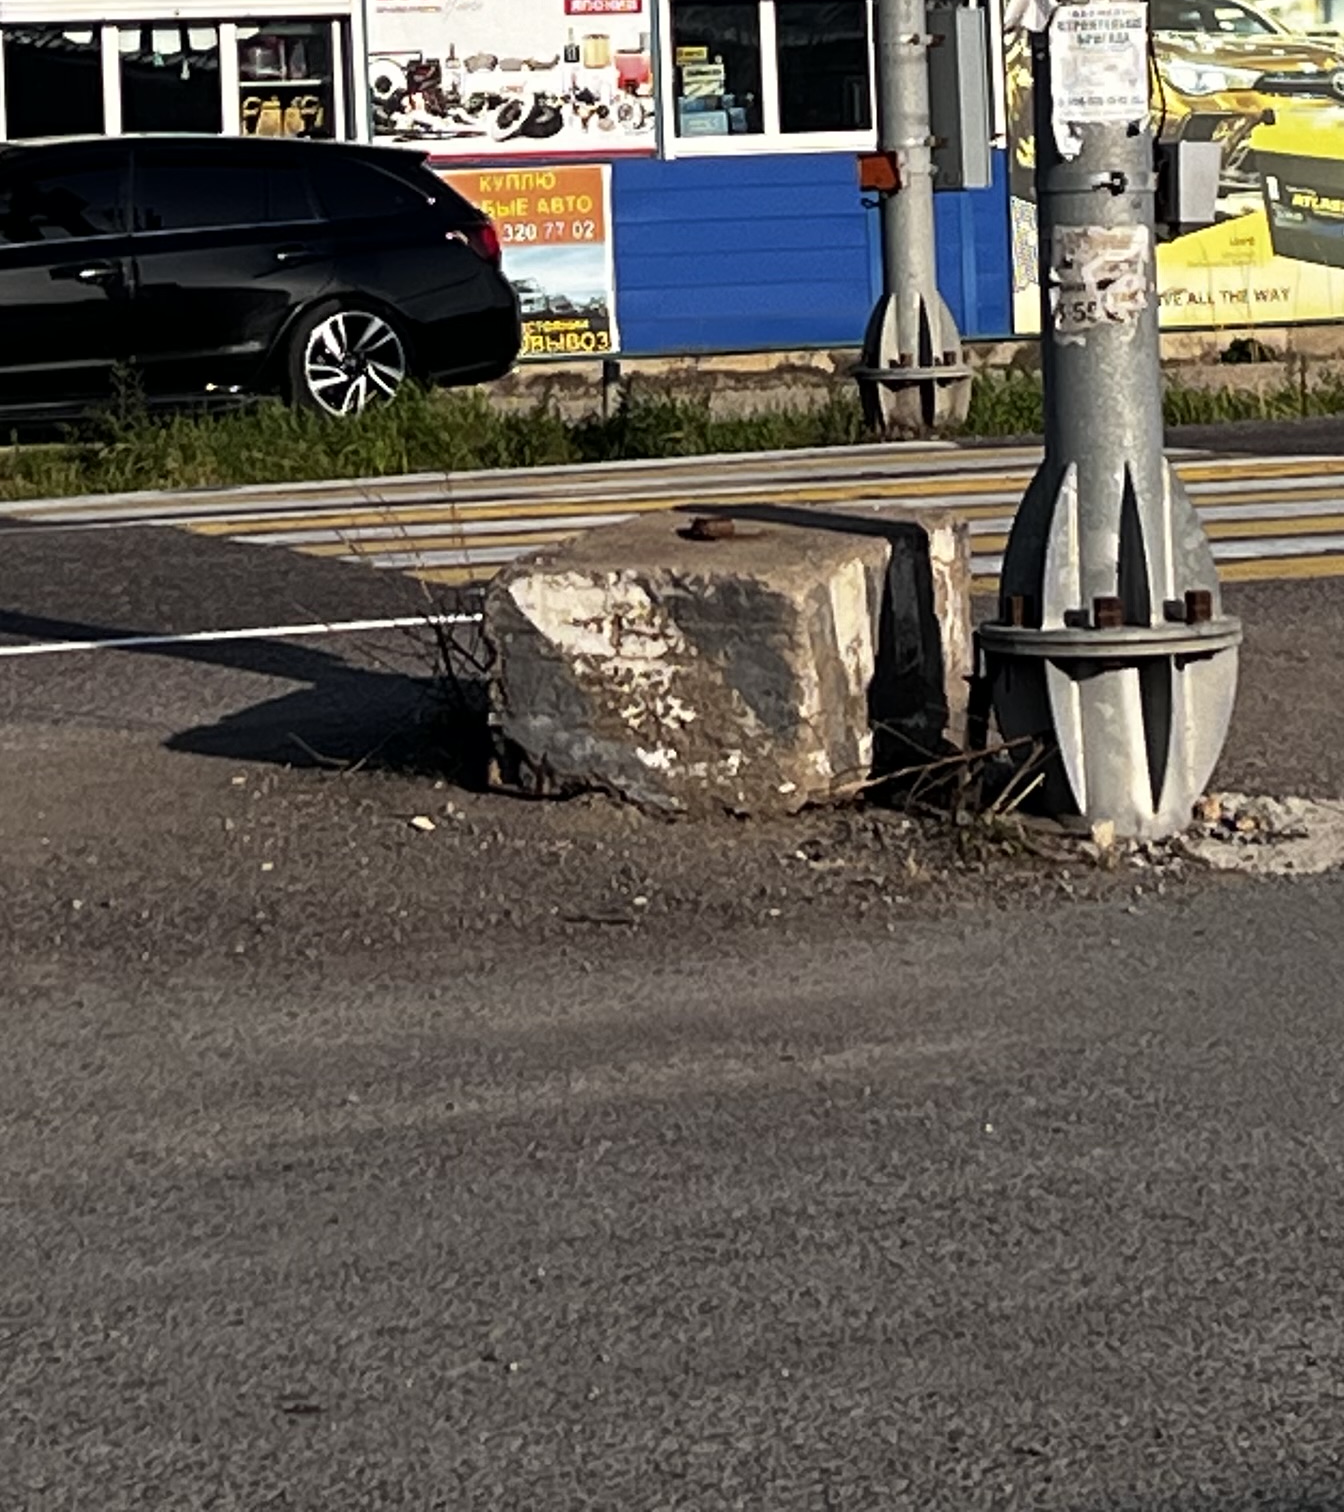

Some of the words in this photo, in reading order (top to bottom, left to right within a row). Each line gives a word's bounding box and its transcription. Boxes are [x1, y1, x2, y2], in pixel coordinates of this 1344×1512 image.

[479, 171, 557, 193] КУПЛЮ
[481, 197, 529, 219] БЫЕ
[537, 195, 593, 215] АВТО
[502, 223, 537, 242] 320
[572, 220, 595, 238] 02
[1219, 289, 1249, 304] THE
[1254, 287, 1290, 303] WAY
